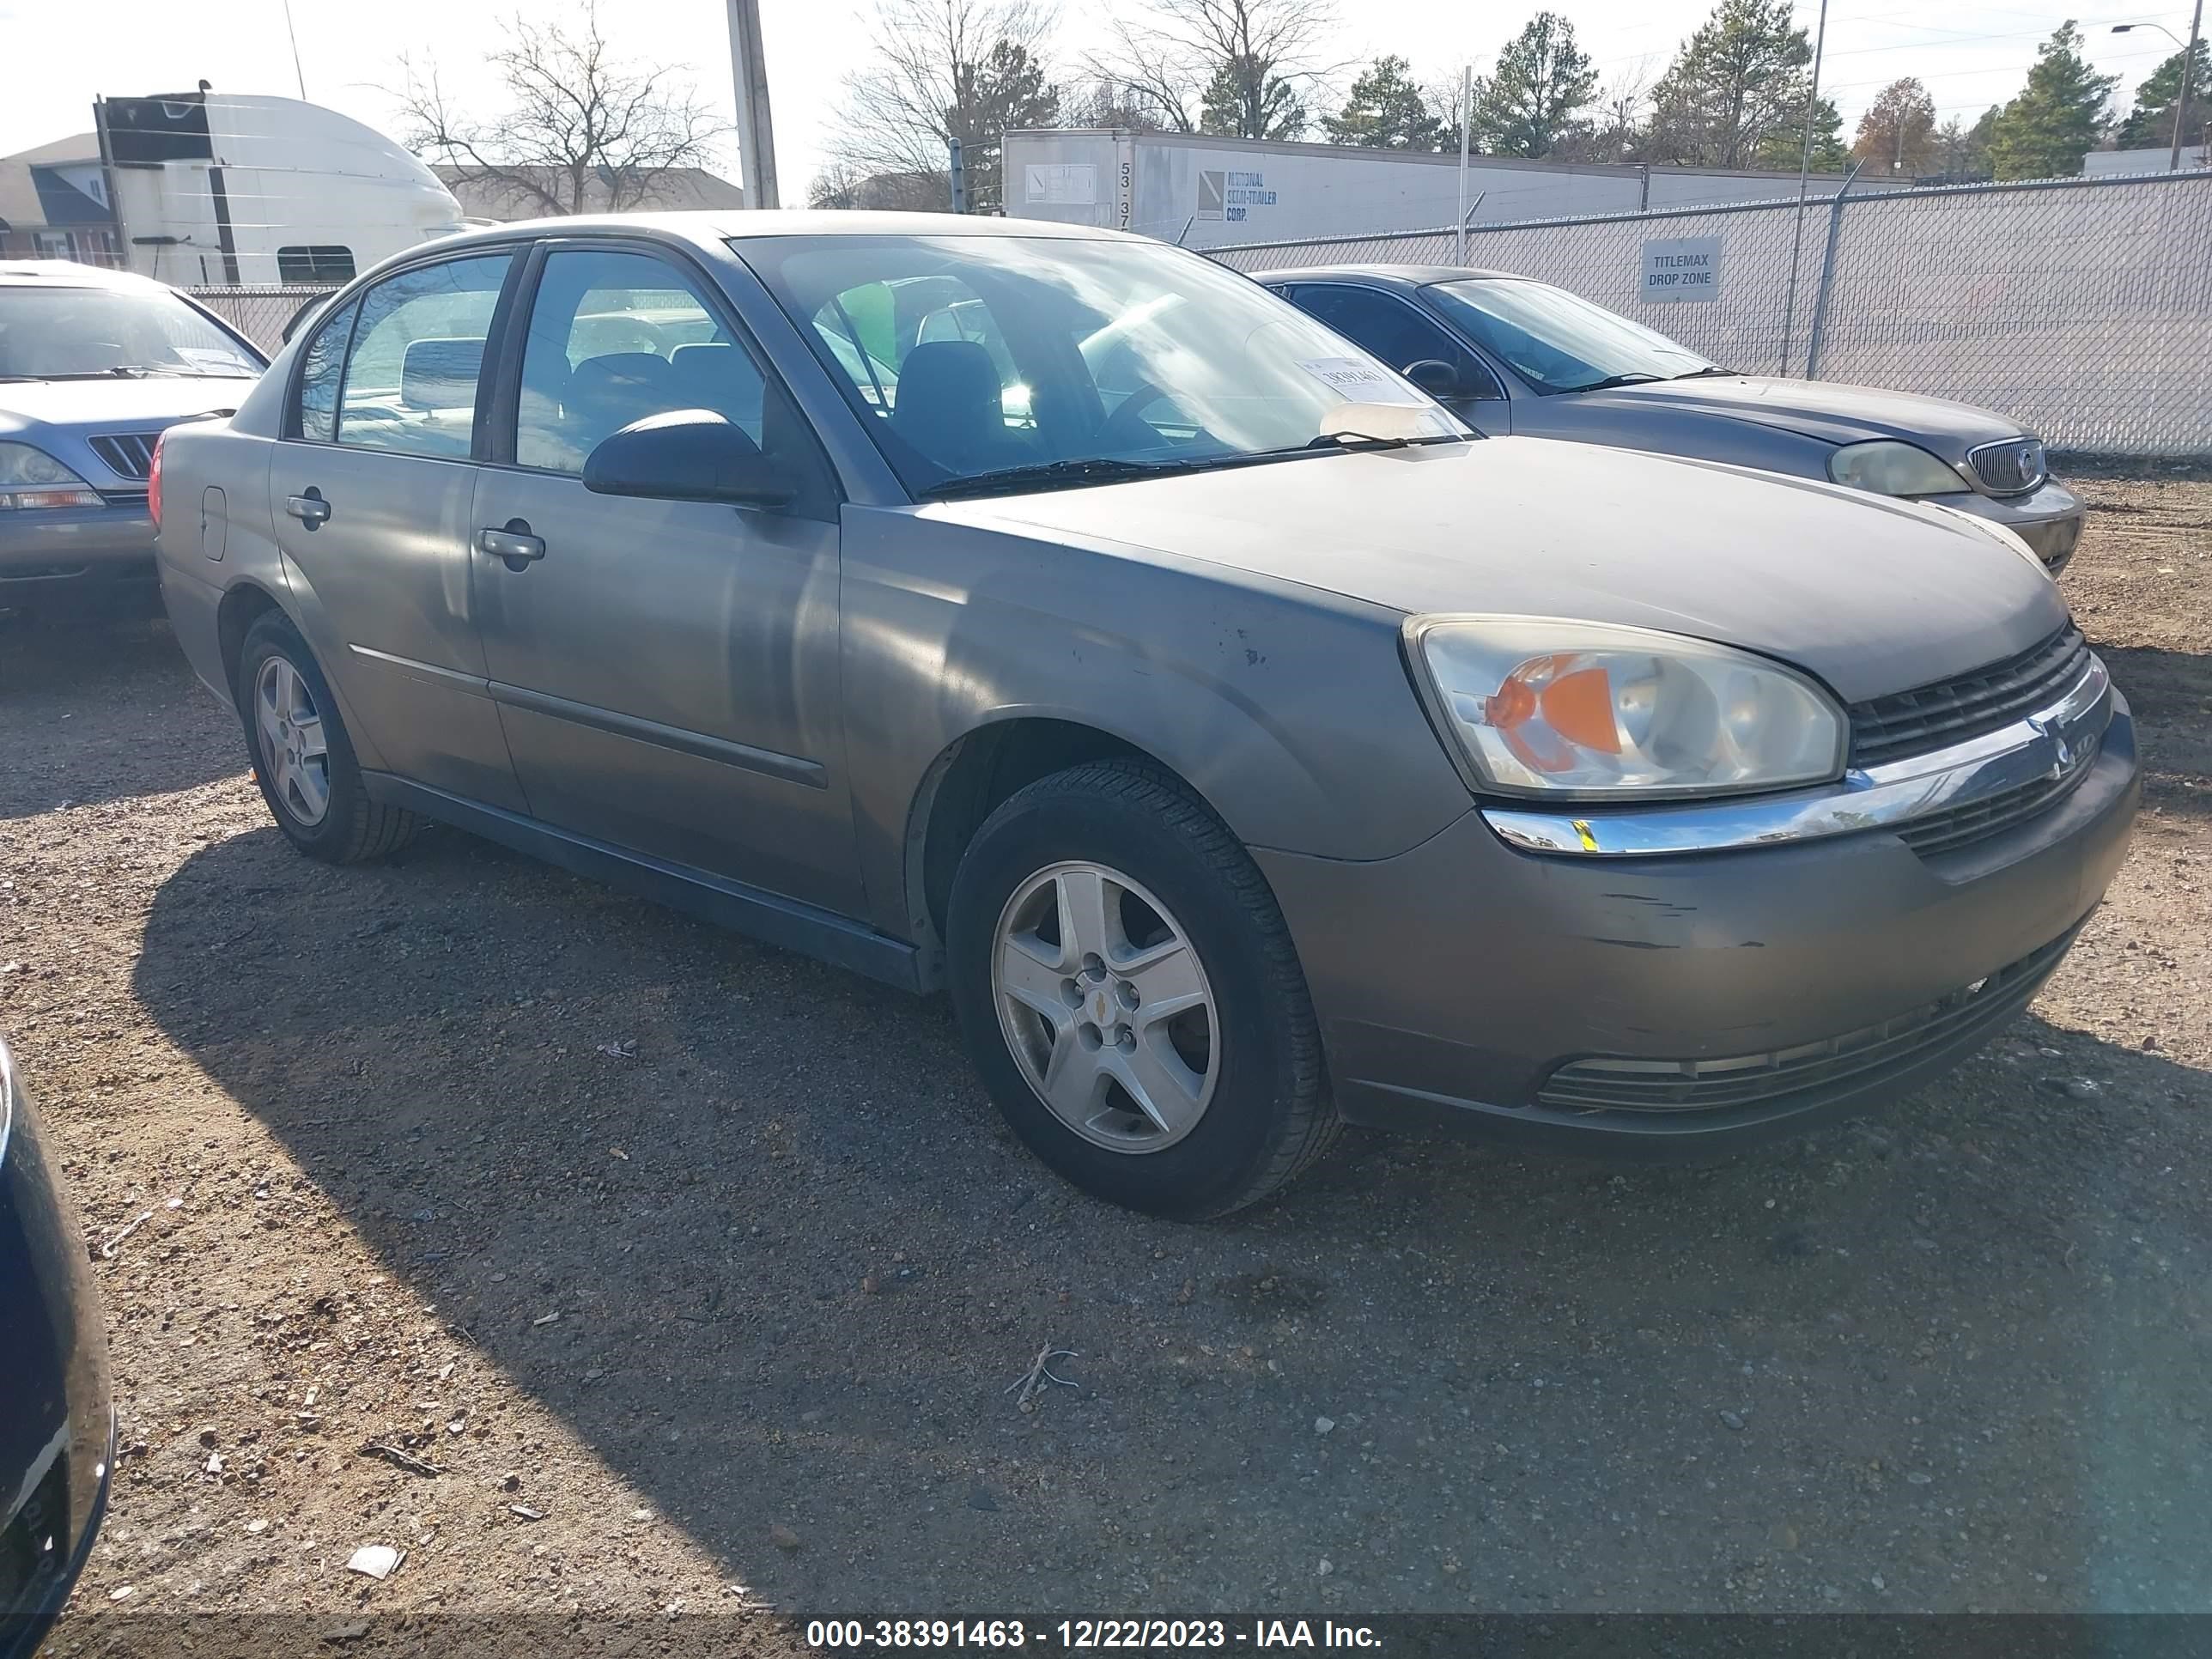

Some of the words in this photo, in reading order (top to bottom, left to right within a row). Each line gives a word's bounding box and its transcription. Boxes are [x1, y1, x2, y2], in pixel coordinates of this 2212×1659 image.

[1227, 190, 1277, 205] SEMI-TRAILER
[1226, 208, 1247, 222] CORP.
[1654, 254, 1709, 268] TITLEMAX
[1649, 273, 1679, 286] DROP
[1682, 272, 1711, 284] ZONE
